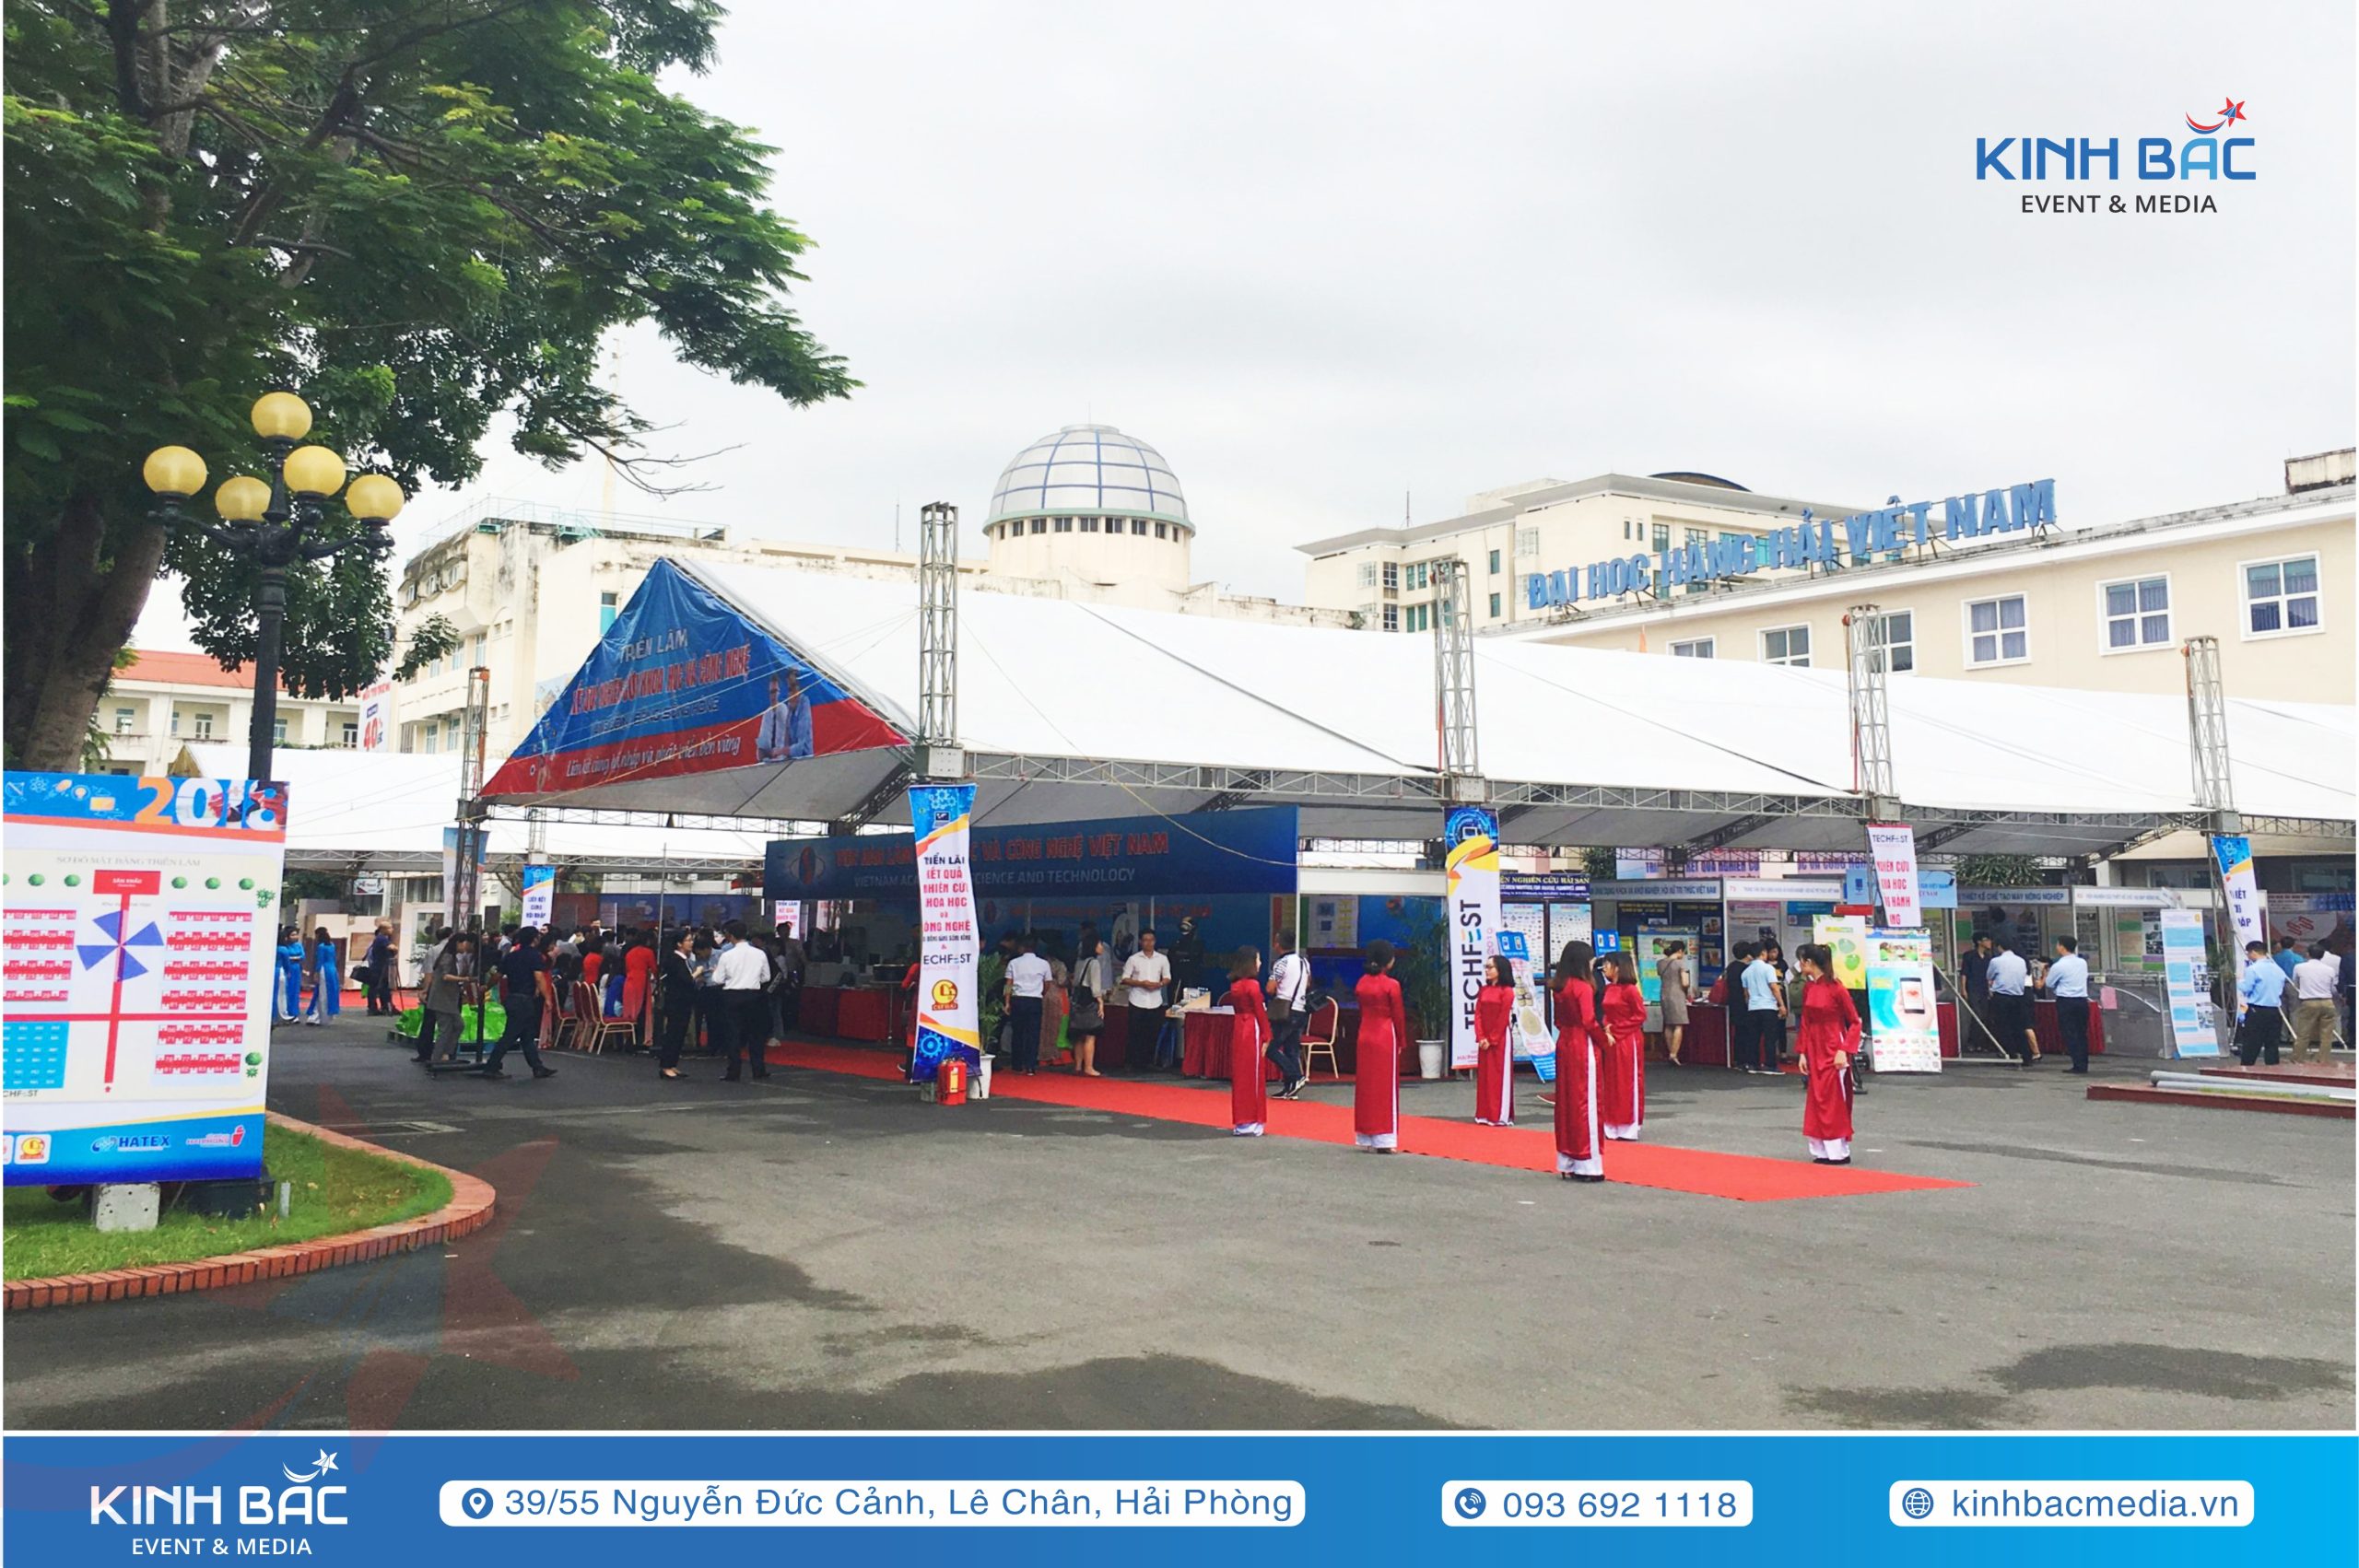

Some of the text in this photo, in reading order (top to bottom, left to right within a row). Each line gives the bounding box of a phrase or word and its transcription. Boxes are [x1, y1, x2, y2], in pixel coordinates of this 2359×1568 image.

[1529, 478, 2056, 612] ĐẠI HỌC HÀNG HẢI VIỆT NAM
[135, 777, 288, 831] 2018
[1127, 831, 1169, 856] NAM
[1017, 870, 1044, 883] AND
[1048, 868, 1135, 883] TECHNOLOGY
[1460, 899, 1483, 1030] TECHFEST
[118, 1135, 170, 1148] HATEX
